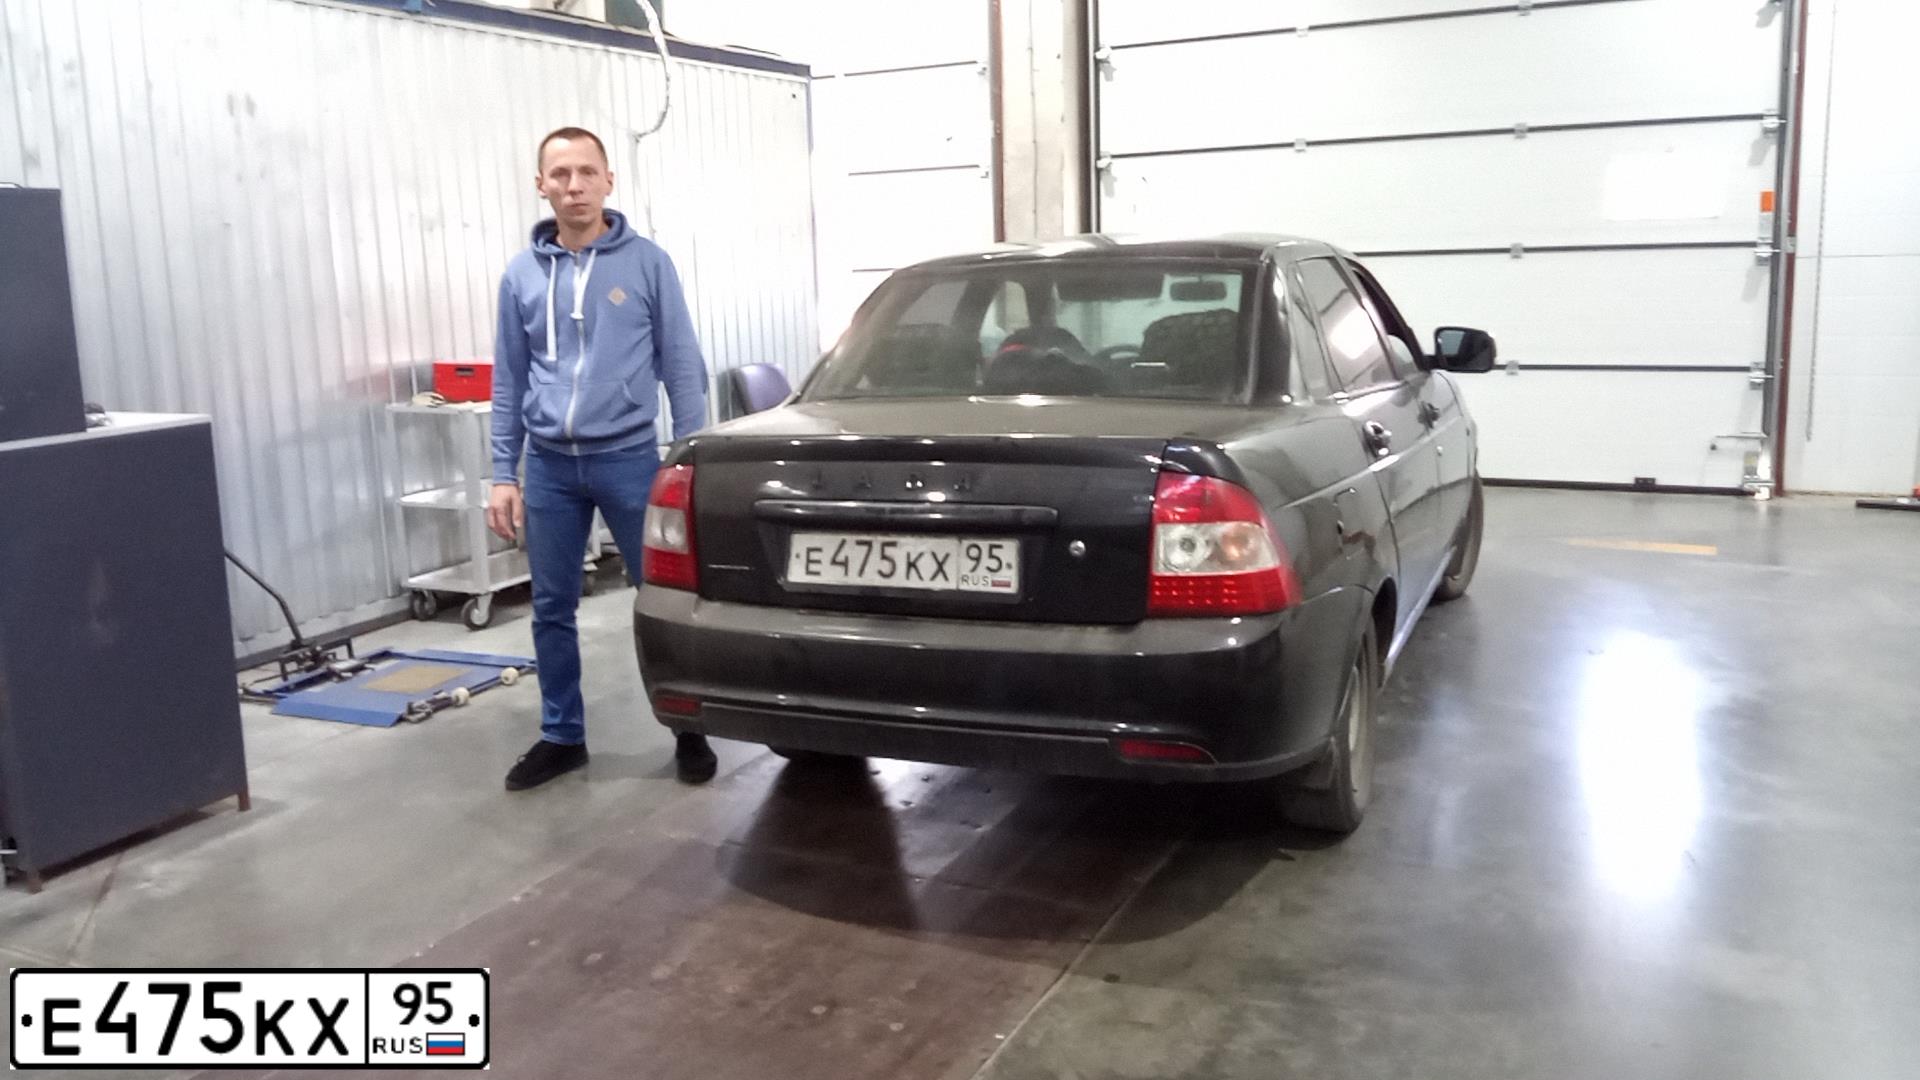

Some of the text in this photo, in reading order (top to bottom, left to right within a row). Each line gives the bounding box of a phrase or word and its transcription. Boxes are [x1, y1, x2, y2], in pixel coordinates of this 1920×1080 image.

[805, 538, 1004, 582] E475KX 95
[961, 574, 989, 587] RUS
